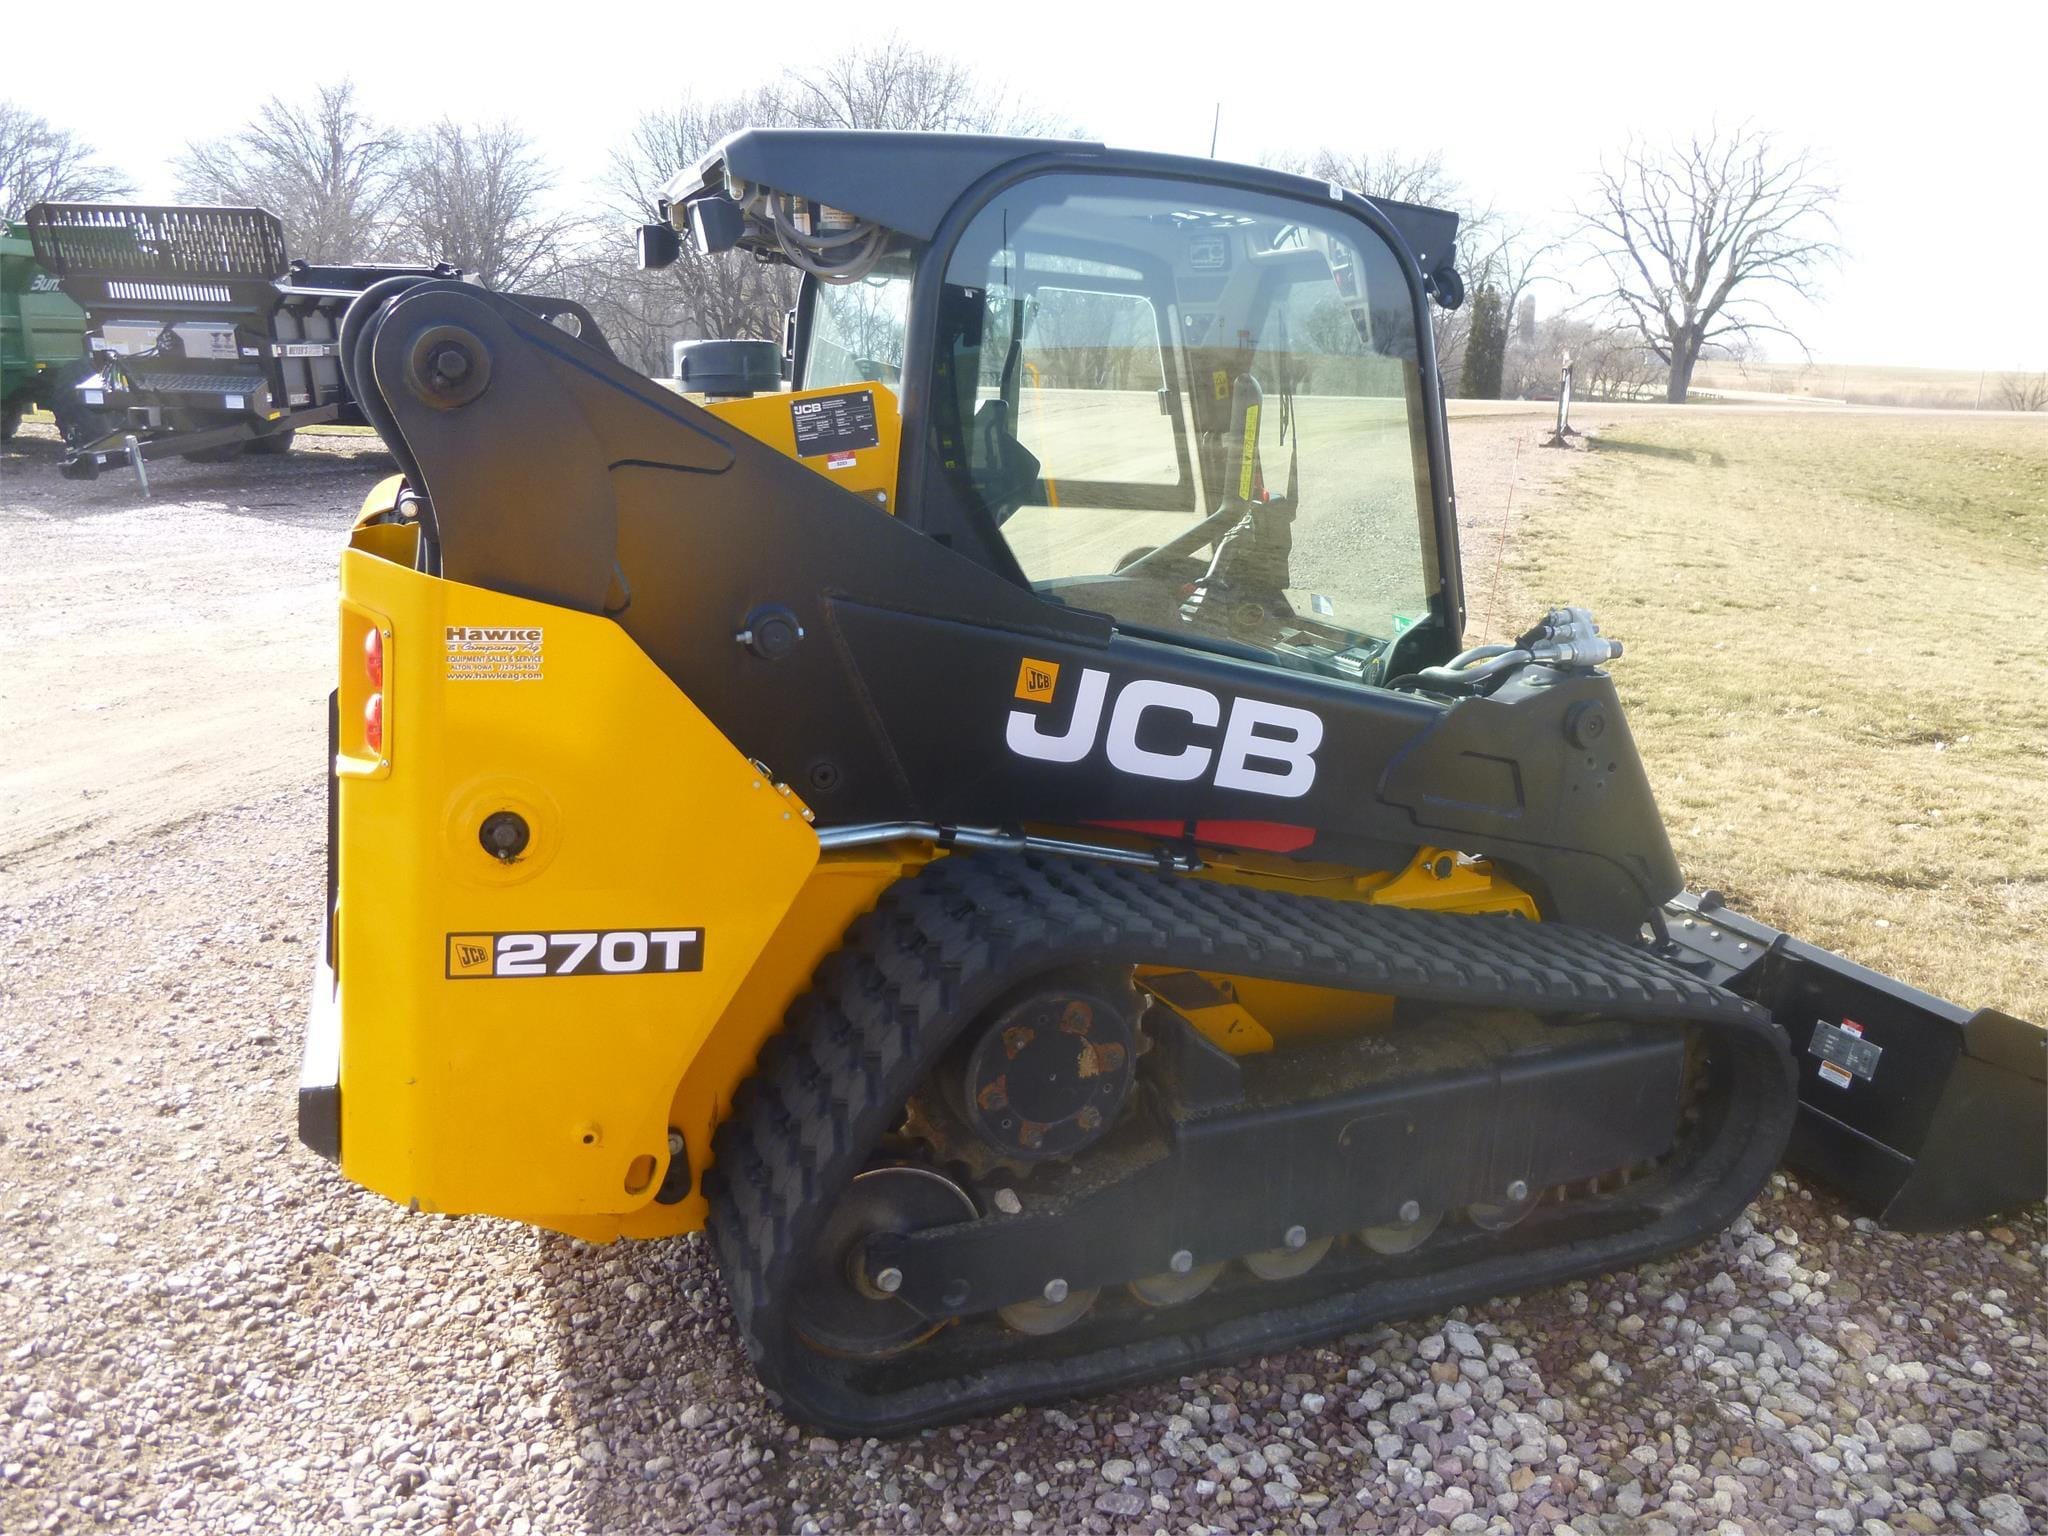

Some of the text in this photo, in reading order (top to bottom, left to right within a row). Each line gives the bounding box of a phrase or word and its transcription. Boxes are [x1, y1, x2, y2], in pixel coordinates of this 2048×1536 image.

[794, 403, 822, 415] JCB
[446, 627, 541, 641] Hawke
[462, 642, 517, 654] Company
[446, 672, 542, 680] www.hawkeag.com
[1029, 671, 1050, 690] JCB
[1005, 668, 1324, 798] JCB
[461, 946, 487, 965] JCB
[496, 931, 697, 975] 270T
